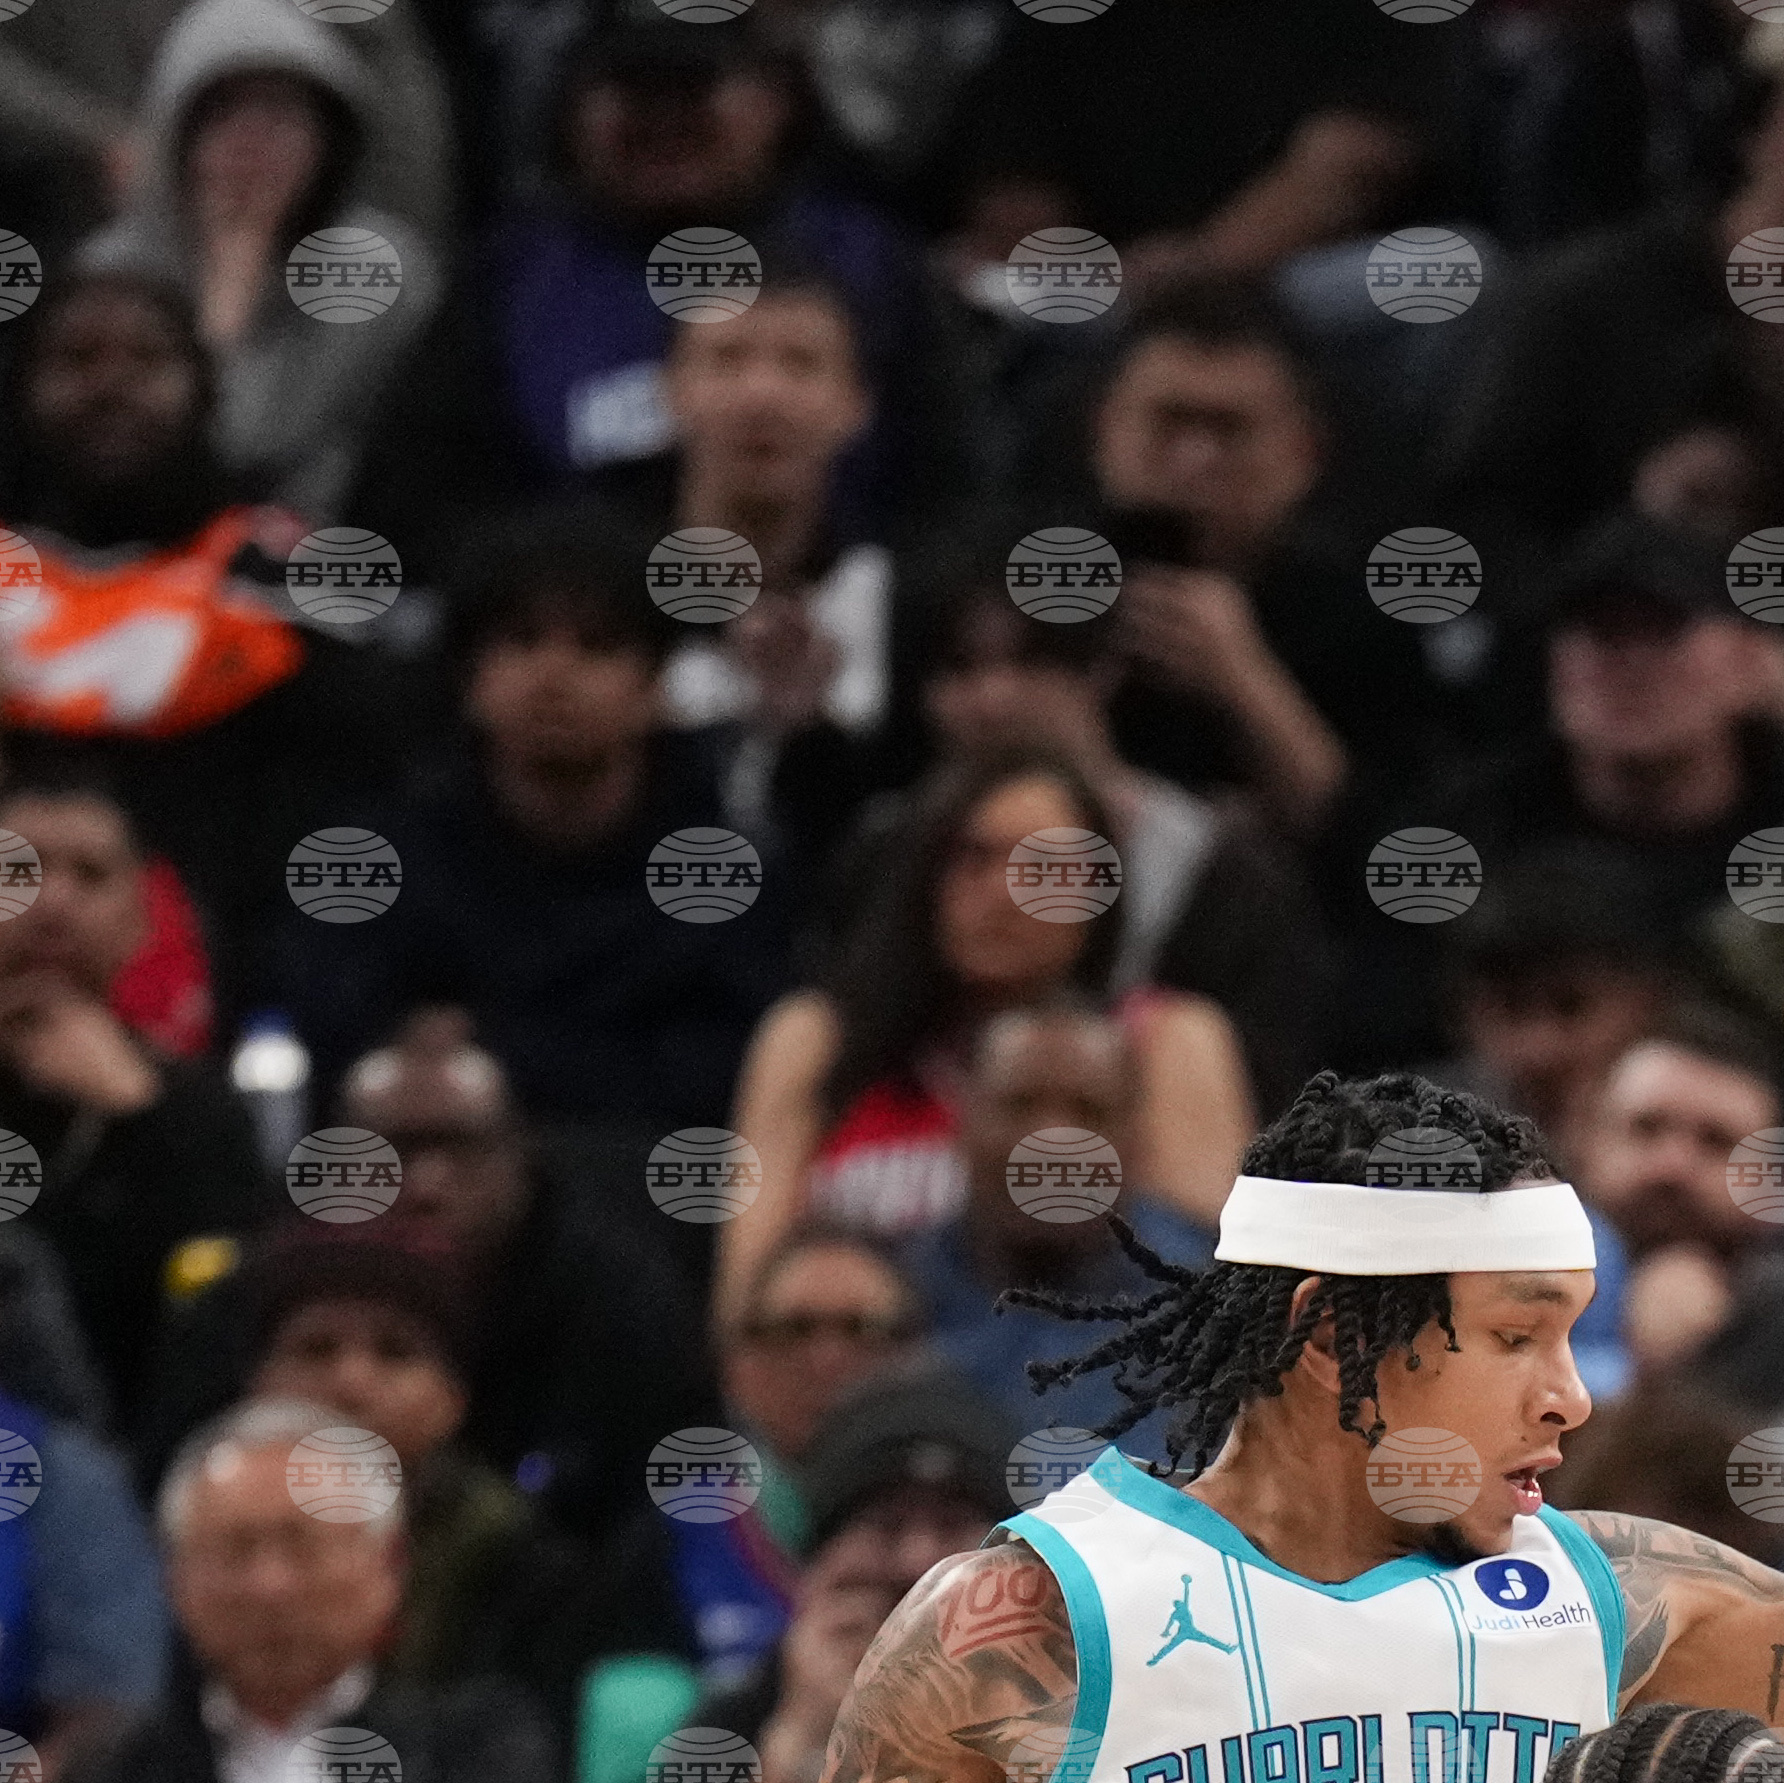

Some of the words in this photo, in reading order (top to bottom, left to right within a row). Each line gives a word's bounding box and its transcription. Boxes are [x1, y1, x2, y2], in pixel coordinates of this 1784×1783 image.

[937, 1565, 1048, 1644] 100
[1472, 1614, 1519, 1631] Judi
[1522, 1602, 1592, 1630] Health
